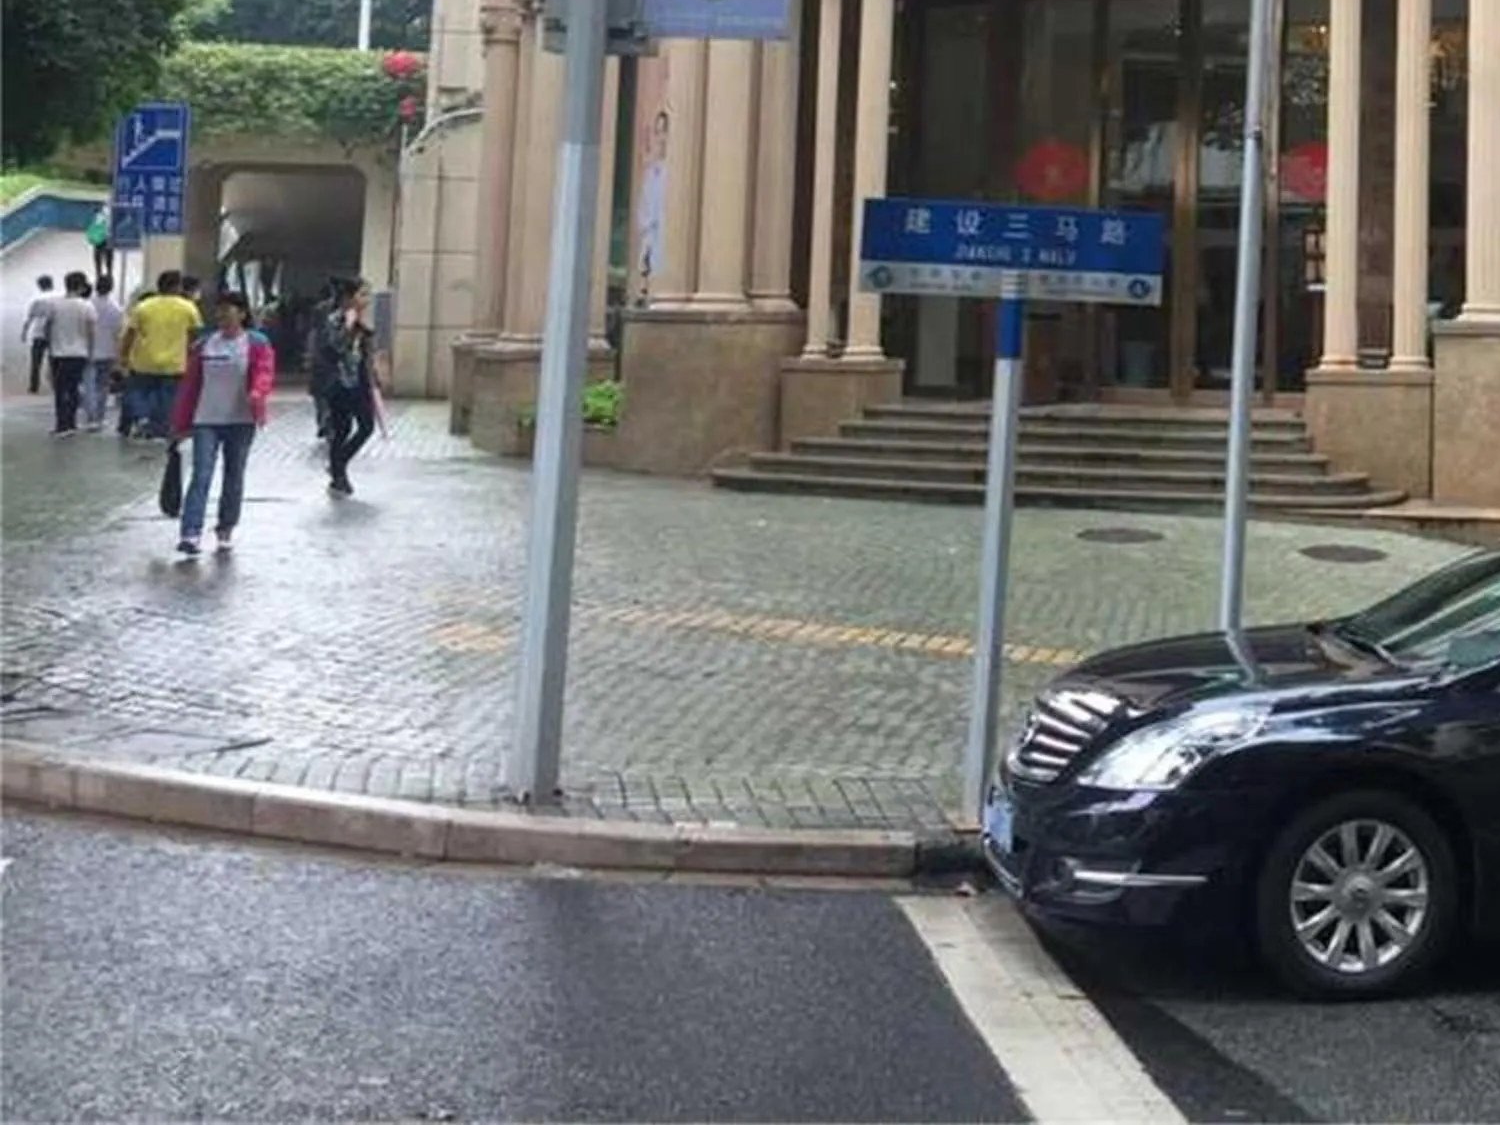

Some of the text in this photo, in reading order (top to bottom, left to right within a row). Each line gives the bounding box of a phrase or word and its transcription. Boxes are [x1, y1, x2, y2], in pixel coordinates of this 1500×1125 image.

[902, 207, 1130, 246] 建设三马路
